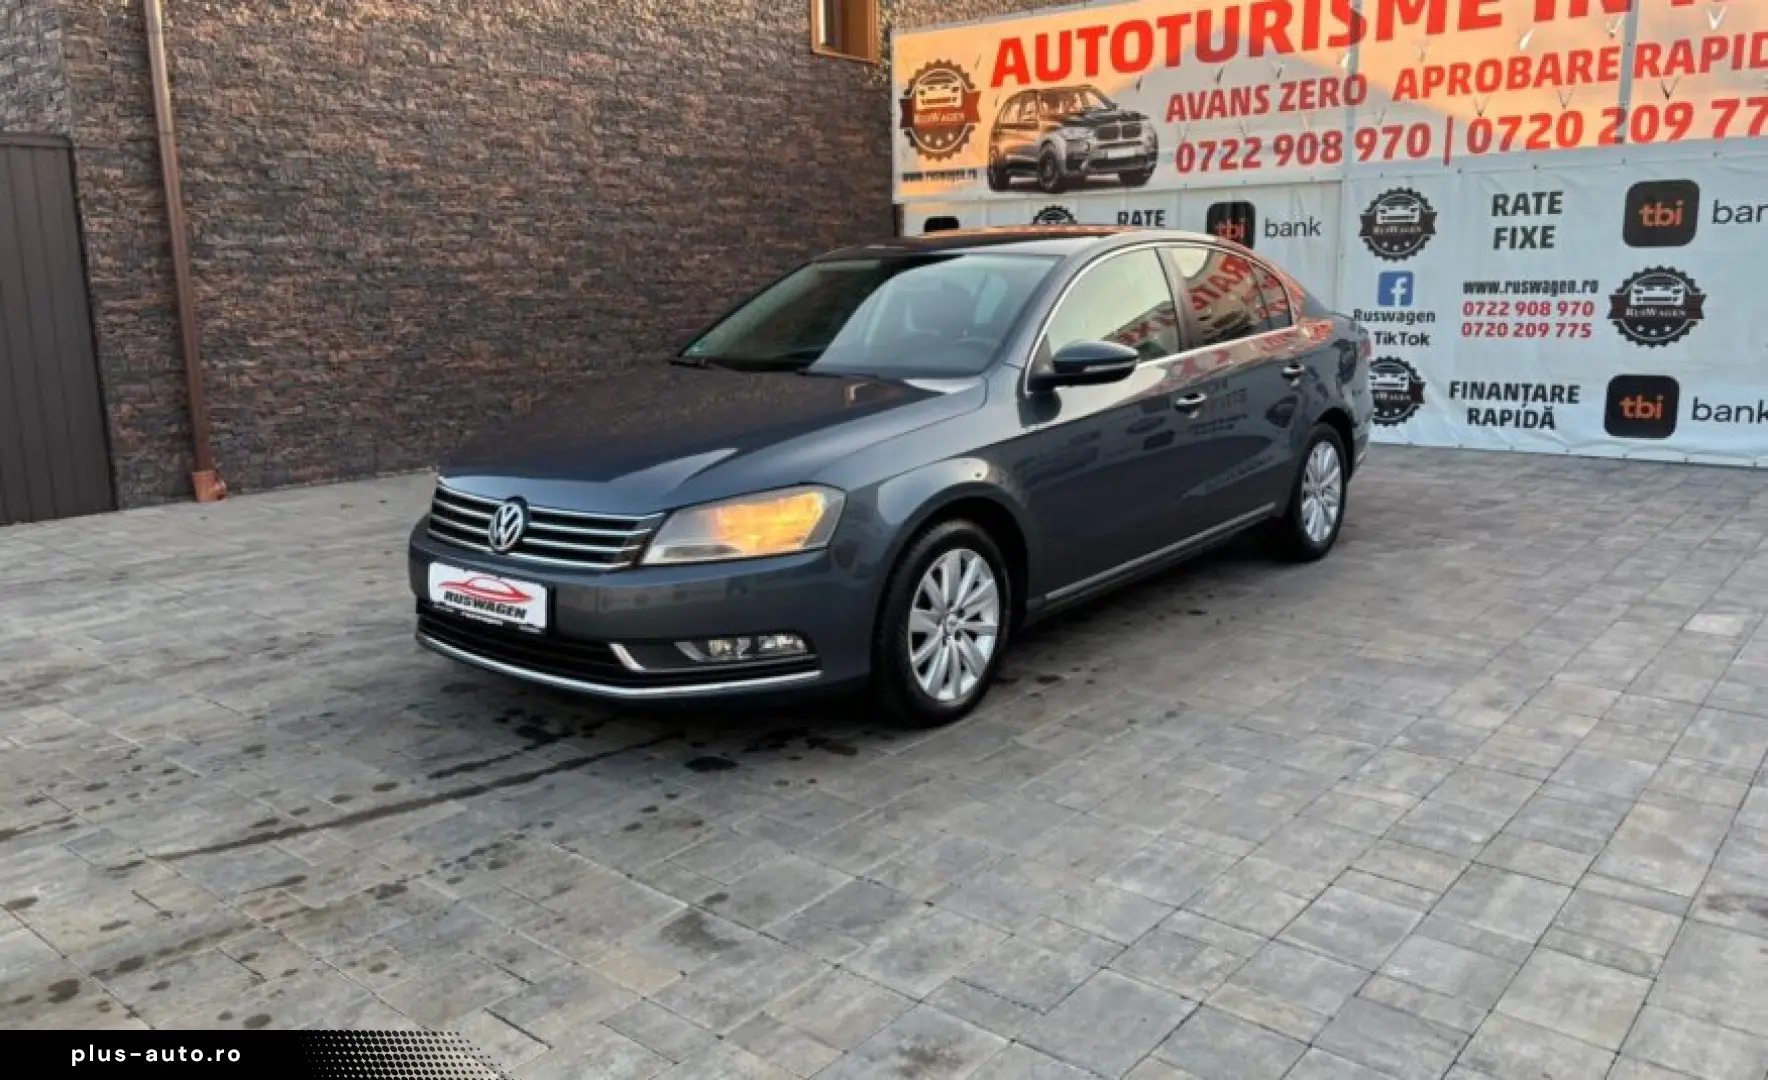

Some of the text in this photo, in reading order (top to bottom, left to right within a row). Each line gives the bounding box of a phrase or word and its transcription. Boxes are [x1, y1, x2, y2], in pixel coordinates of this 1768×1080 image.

[990, 0, 1502, 88] AUTOTURISME
[1167, 84, 1270, 122] AVANS
[1279, 74, 1367, 112] ZERO
[1392, 46, 1621, 102] APROBARE
[1175, 136, 1262, 173] 0722
[1273, 129, 1343, 166] 908
[1354, 122, 1431, 161] 970
[1466, 110, 1584, 154] 0720
[1598, 102, 1694, 145] 209
[1491, 191, 1564, 216] RATE
[1638, 200, 1684, 227] tbi
[1264, 216, 1323, 238] bank
[1493, 224, 1556, 250] FIXE
[1463, 280, 1599, 297] www.ruswagen.ro
[1354, 309, 1435, 326] Ruswagen
[1463, 301, 1595, 316] 0722 908 970
[1374, 330, 1431, 346] TikTok
[1462, 322, 1592, 338] 0720 209 775
[1467, 405, 1556, 430] RAPIDĂ
[1620, 394, 1768, 424] tbi bank
[444, 591, 527, 619] RUSWAGEN
